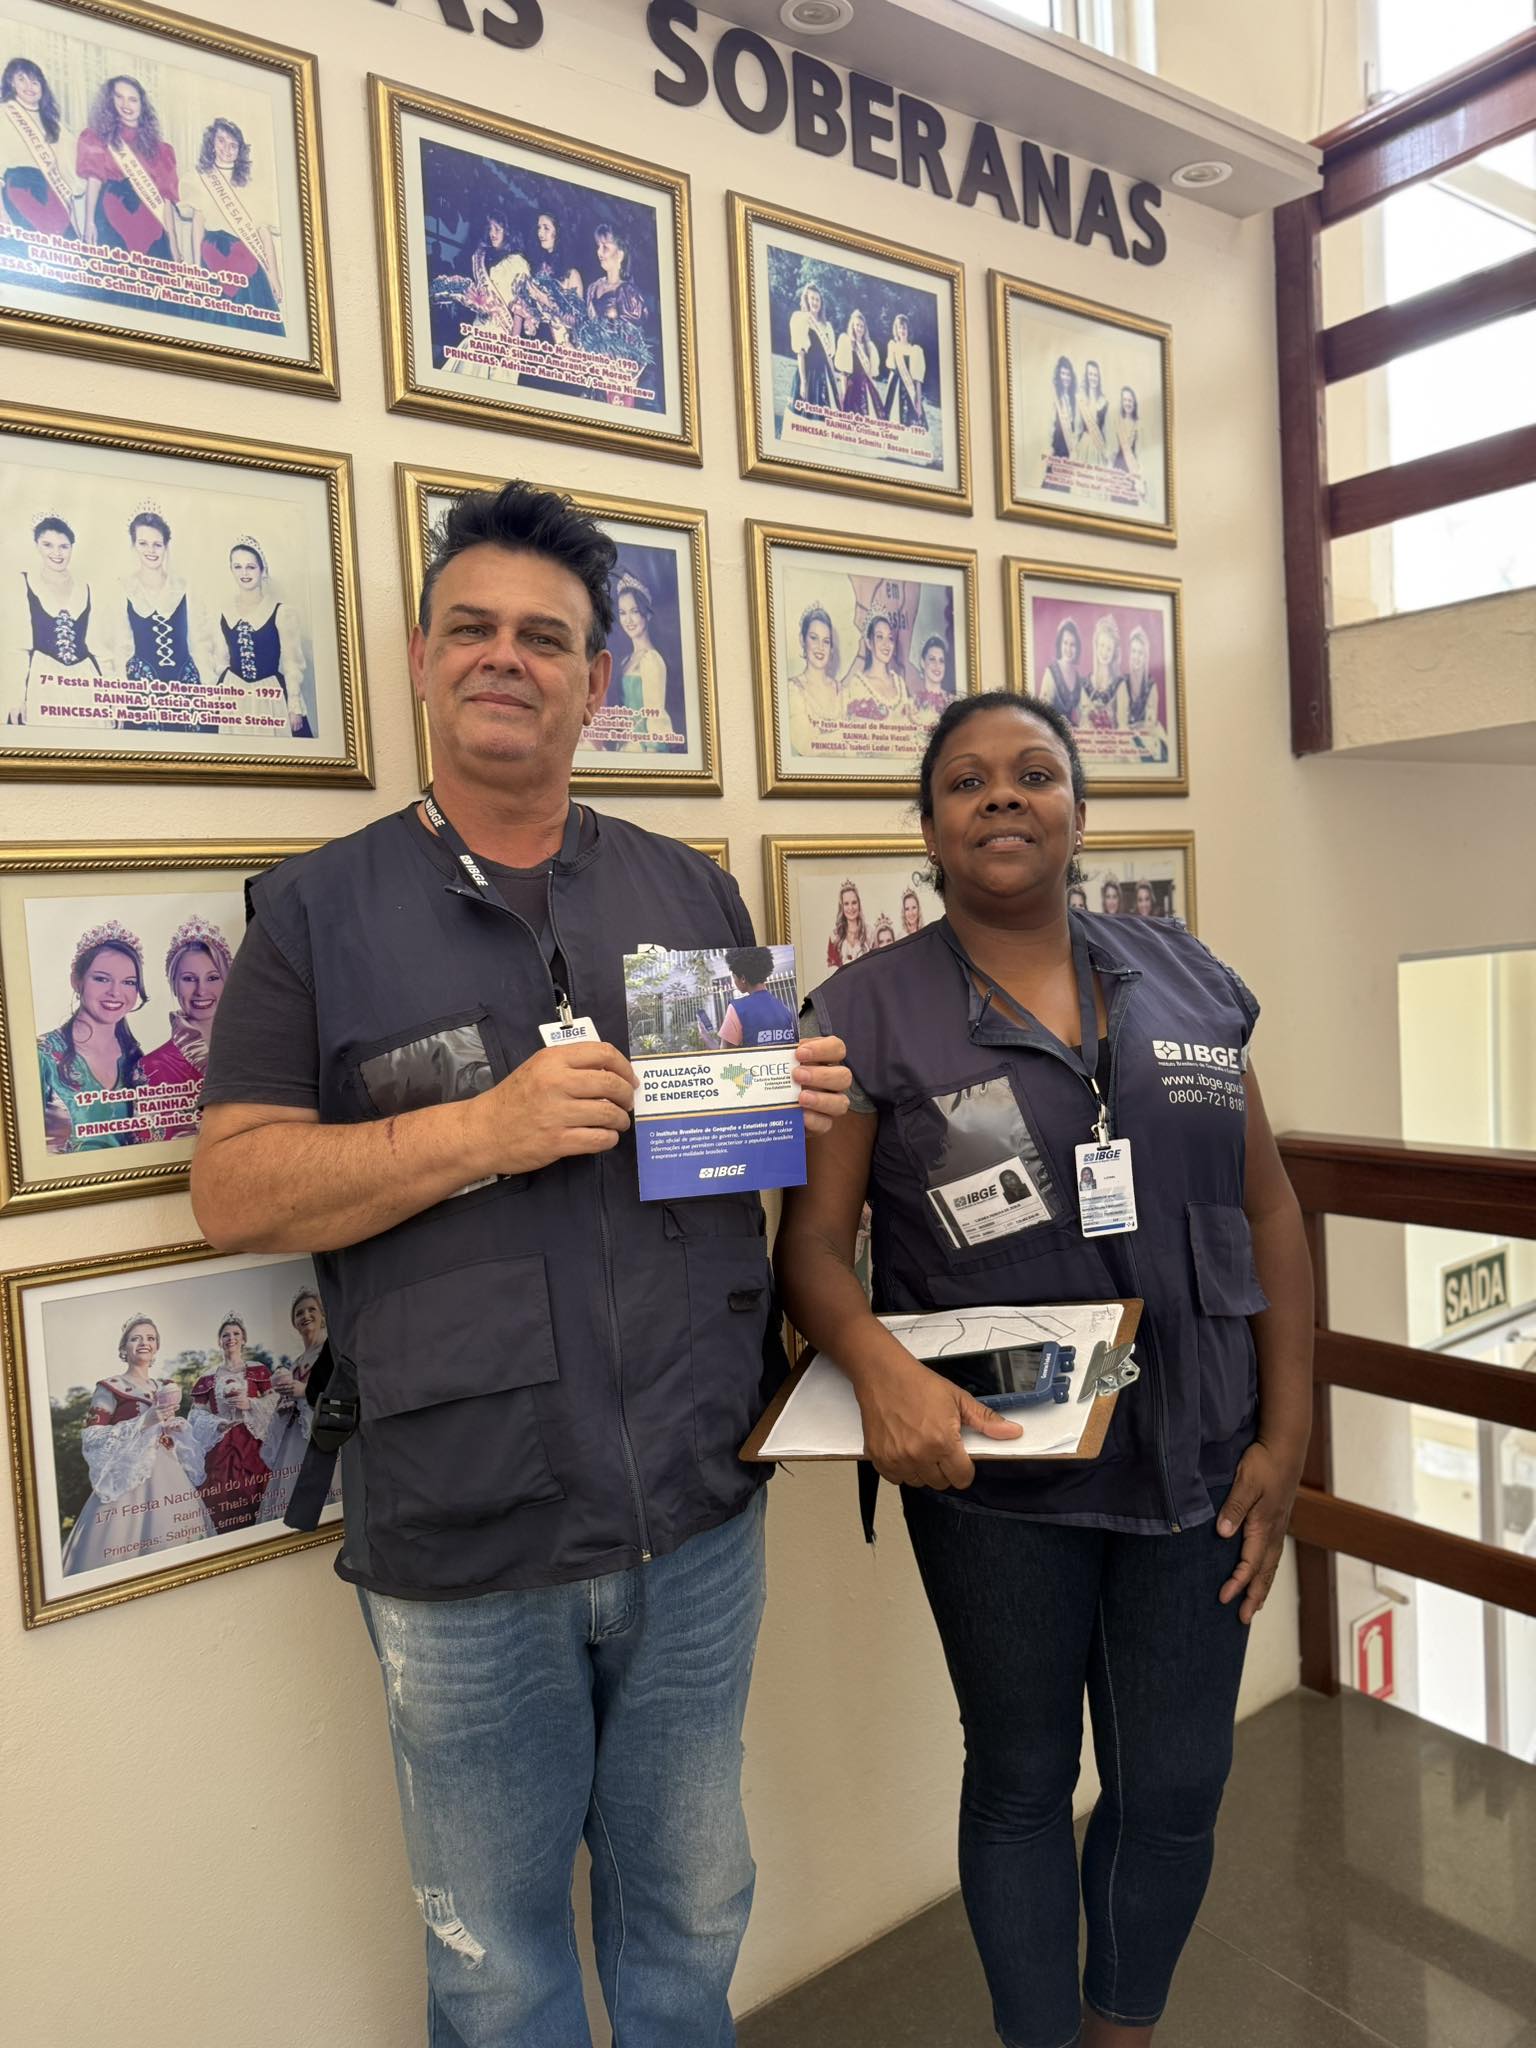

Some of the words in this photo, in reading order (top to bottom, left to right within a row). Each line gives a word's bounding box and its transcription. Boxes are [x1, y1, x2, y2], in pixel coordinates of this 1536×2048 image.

[649, 0, 1166, 266] SOBERANAS
[15, 228, 48, 245] Festa
[52, 236, 109, 258] Nacional
[112, 248, 129, 260] do
[132, 253, 210, 280] Moranguinho
[220, 272, 248, 288] 1988
[31, 247, 87, 269] RAINHA:
[90, 259, 137, 280] Claudia
[140, 269, 181, 289] Raquel
[184, 279, 222, 297] Müller
[105, 278, 151, 297] Schmitz
[162, 289, 202, 307] Marcia
[204, 298, 244, 315] Steffen
[247, 306, 281, 322] Torres
[461, 324, 474, 335] 3ª
[474, 328, 498, 341] Festa
[500, 334, 540, 350] Nacional
[541, 341, 554, 353] do
[555, 345, 611, 367] Moranguinho
[617, 357, 639, 372] 1990
[444, 346, 499, 367] PRINCESAS:
[501, 357, 537, 376] Adriane
[538, 366, 564, 381] Maria
[564, 372, 587, 386] Heck
[592, 379, 623, 393] Susana
[470, 340, 510, 357] RAINHA:
[511, 348, 545, 364] Silvana
[546, 356, 588, 375] Amarante
[602, 368, 633, 383] Moraes
[791, 422, 830, 438] PRINCESAS:
[40, 674, 54, 686] 7ª
[57, 675, 90, 688] Festa
[93, 678, 147, 692] Nacional
[151, 682, 168, 692] do
[170, 683, 246, 699] Moranguinho
[256, 688, 282, 699] 1997
[94, 693, 147, 707] RAINHA:
[193, 698, 237, 710] Chassot
[40, 705, 113, 719] PRINCESAS:
[116, 708, 157, 724] Magali
[160, 711, 190, 723] Birck
[200, 713, 242, 726] Simone
[245, 714, 286, 728] Ströher
[593, 718, 632, 728] Schneider
[641, 707, 660, 718] 1999
[583, 730, 609, 739] Dilene
[611, 731, 650, 743] Rodrigues
[652, 733, 663, 741] Da
[665, 733, 684, 743] Silva
[839, 722, 867, 730] Nacional
[811, 742, 848, 750] PRINCESAS:
[427, 806, 446, 829] IBGE
[466, 864, 489, 888] IBGE
[561, 1026, 587, 1039] IBGE
[773, 1028, 796, 1042] IBGE
[1183, 1043, 1240, 1069] IBGE
[643, 1064, 711, 1079] ATUALIZAÇÃO
[76, 1093, 98, 1105] 12ª
[102, 1089, 135, 1101] Festa
[138, 1082, 193, 1098] Nacional
[644, 1081, 658, 1091] DO
[661, 1076, 714, 1090] CADASTRO
[140, 1098, 194, 1113] RAINHA:
[645, 1093, 658, 1103] DE
[661, 1088, 720, 1101] ENDEREÇOS
[1168, 1089, 1227, 1108] 0800-721
[77, 1117, 152, 1136] PRINCESAS:
[154, 1112, 193, 1127] Janice
[1094, 1149, 1122, 1161] IBGE
[713, 1163, 747, 1178] IBGE
[966, 1184, 998, 1204] IBGE
[1445, 1261, 1506, 1323] SAÍDA
[122, 1500, 161, 1518] Festa
[164, 1484, 223, 1508] Nacional
[224, 1478, 242, 1492] do
[244, 1463, 303, 1489] Morangui
[103, 1534, 163, 1560] Princesas:
